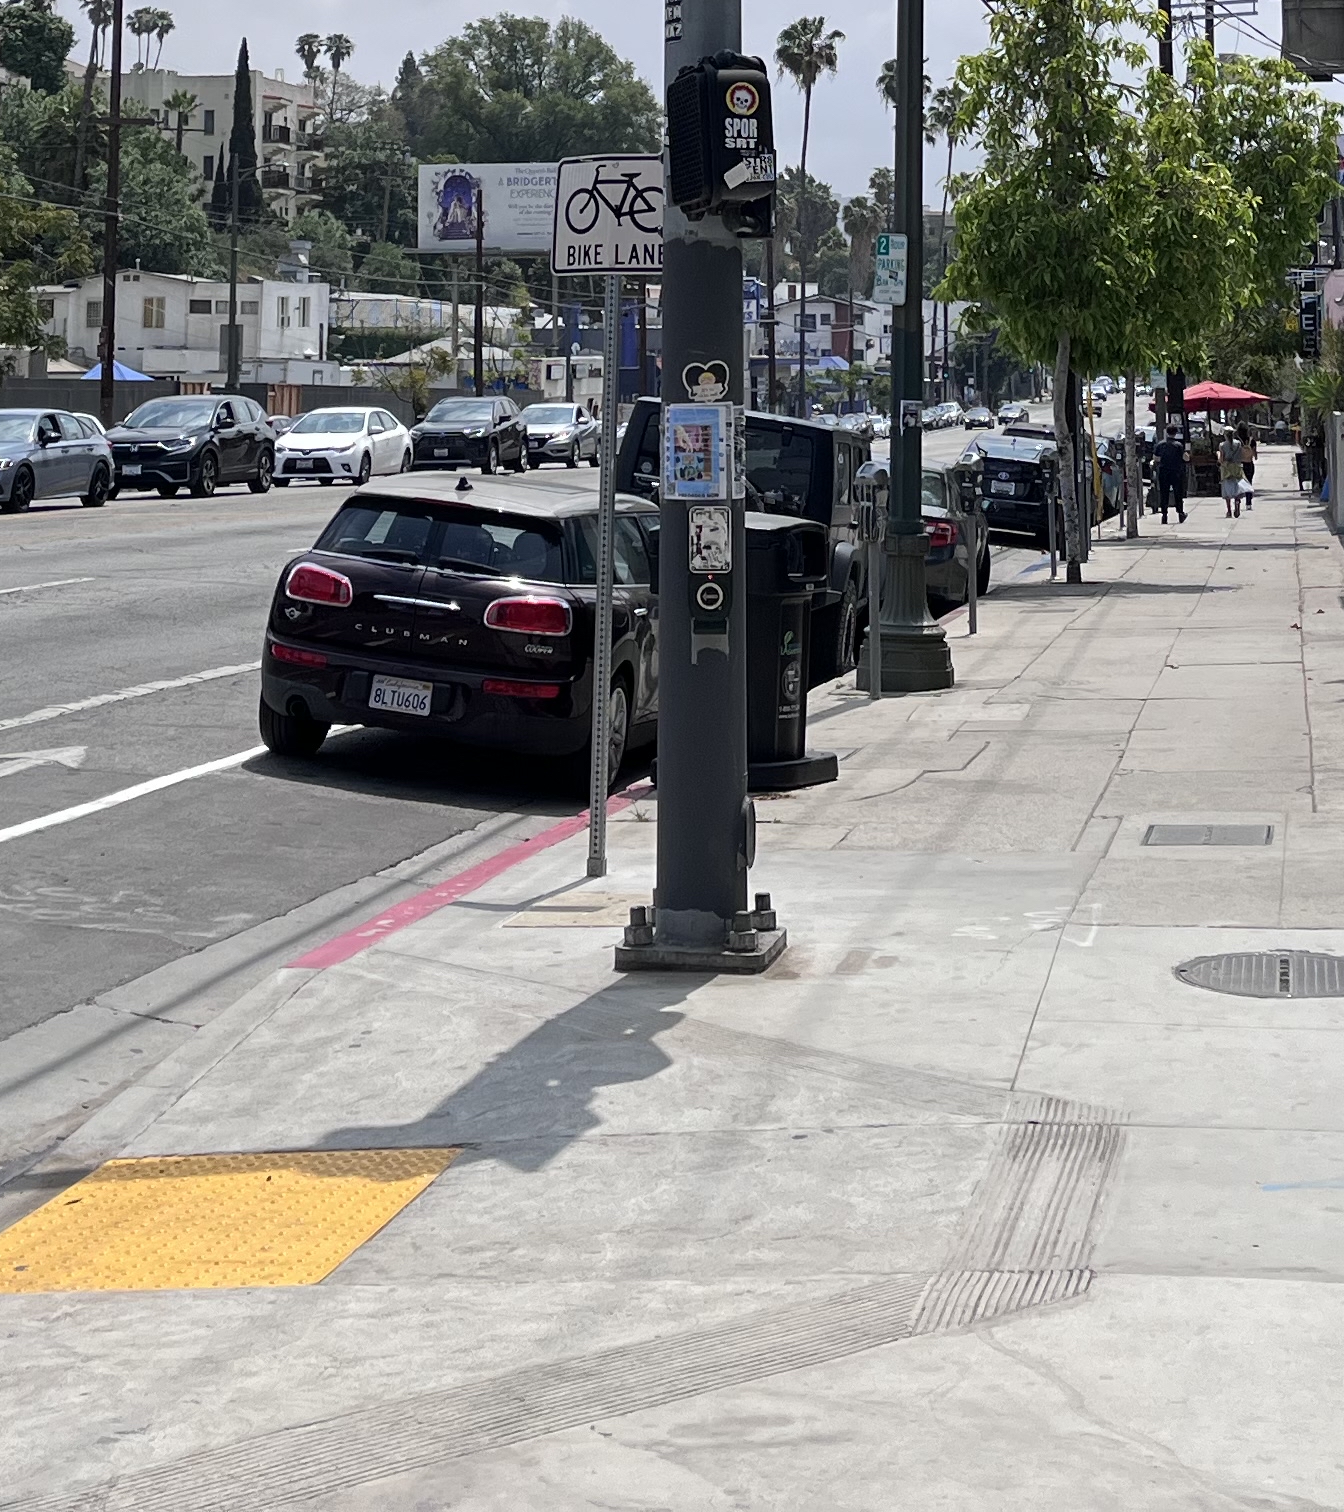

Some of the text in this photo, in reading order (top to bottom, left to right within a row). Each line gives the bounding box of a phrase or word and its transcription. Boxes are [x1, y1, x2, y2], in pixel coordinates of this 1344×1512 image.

[724, 117, 758, 138] SPOR
[724, 138, 758, 149] SRT
[567, 243, 663, 266] BIKE LANE
[879, 237, 887, 253] 2
[877, 258, 905, 273] PARKING
[354, 623, 468, 646] CLUBMAN
[374, 688, 428, 710] 8LTU606
